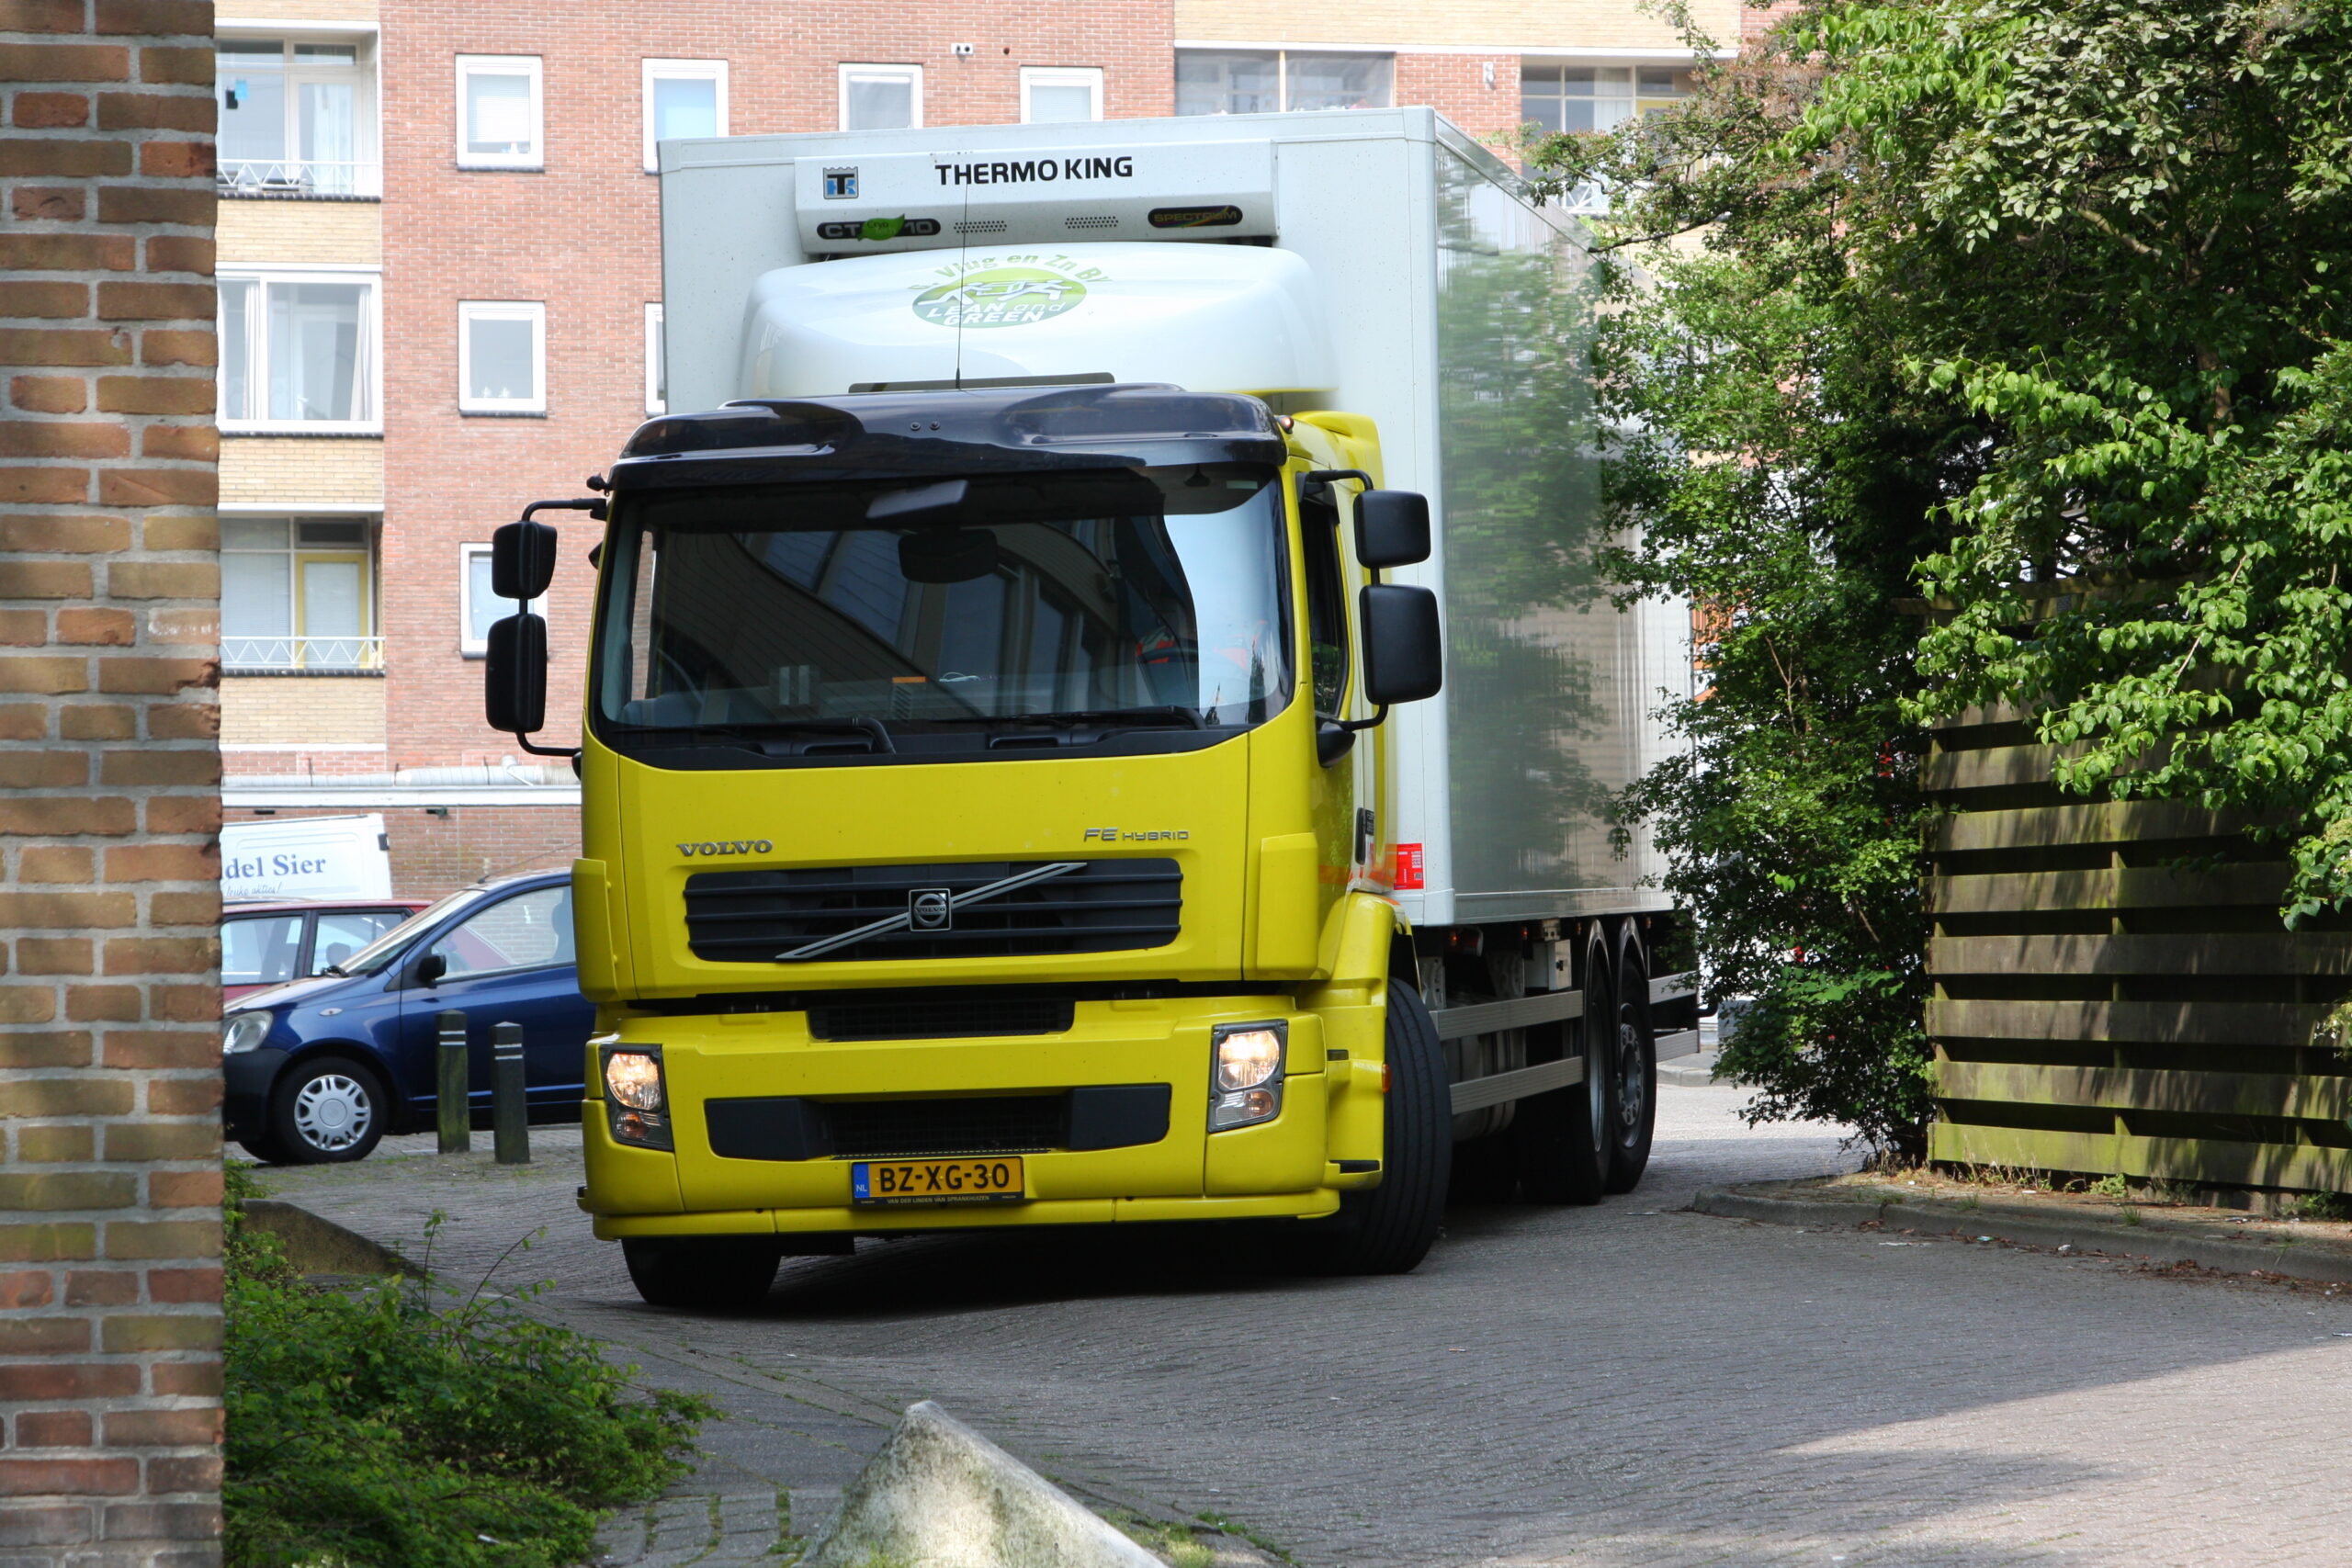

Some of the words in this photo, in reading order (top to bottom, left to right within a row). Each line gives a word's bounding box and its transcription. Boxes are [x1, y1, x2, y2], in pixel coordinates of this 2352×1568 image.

[935, 160, 1057, 185] THERMO
[1065, 156, 1133, 179] KING
[1154, 211, 1237, 222] SPECTRUM
[934, 256, 998, 278] Vlug
[1007, 254, 1039, 264] en
[1044, 254, 1078, 271] Zn
[926, 302, 1006, 318] LEAN
[1013, 301, 1066, 312] and
[944, 311, 1045, 325] GREEN
[1083, 827, 1118, 842] FE
[1123, 830, 1190, 841] HYBRID
[676, 840, 773, 857] VOLVO
[273, 853, 326, 876] Sier
[879, 1163, 1010, 1192] BZ-XG-30
[856, 1184, 867, 1192] NL
